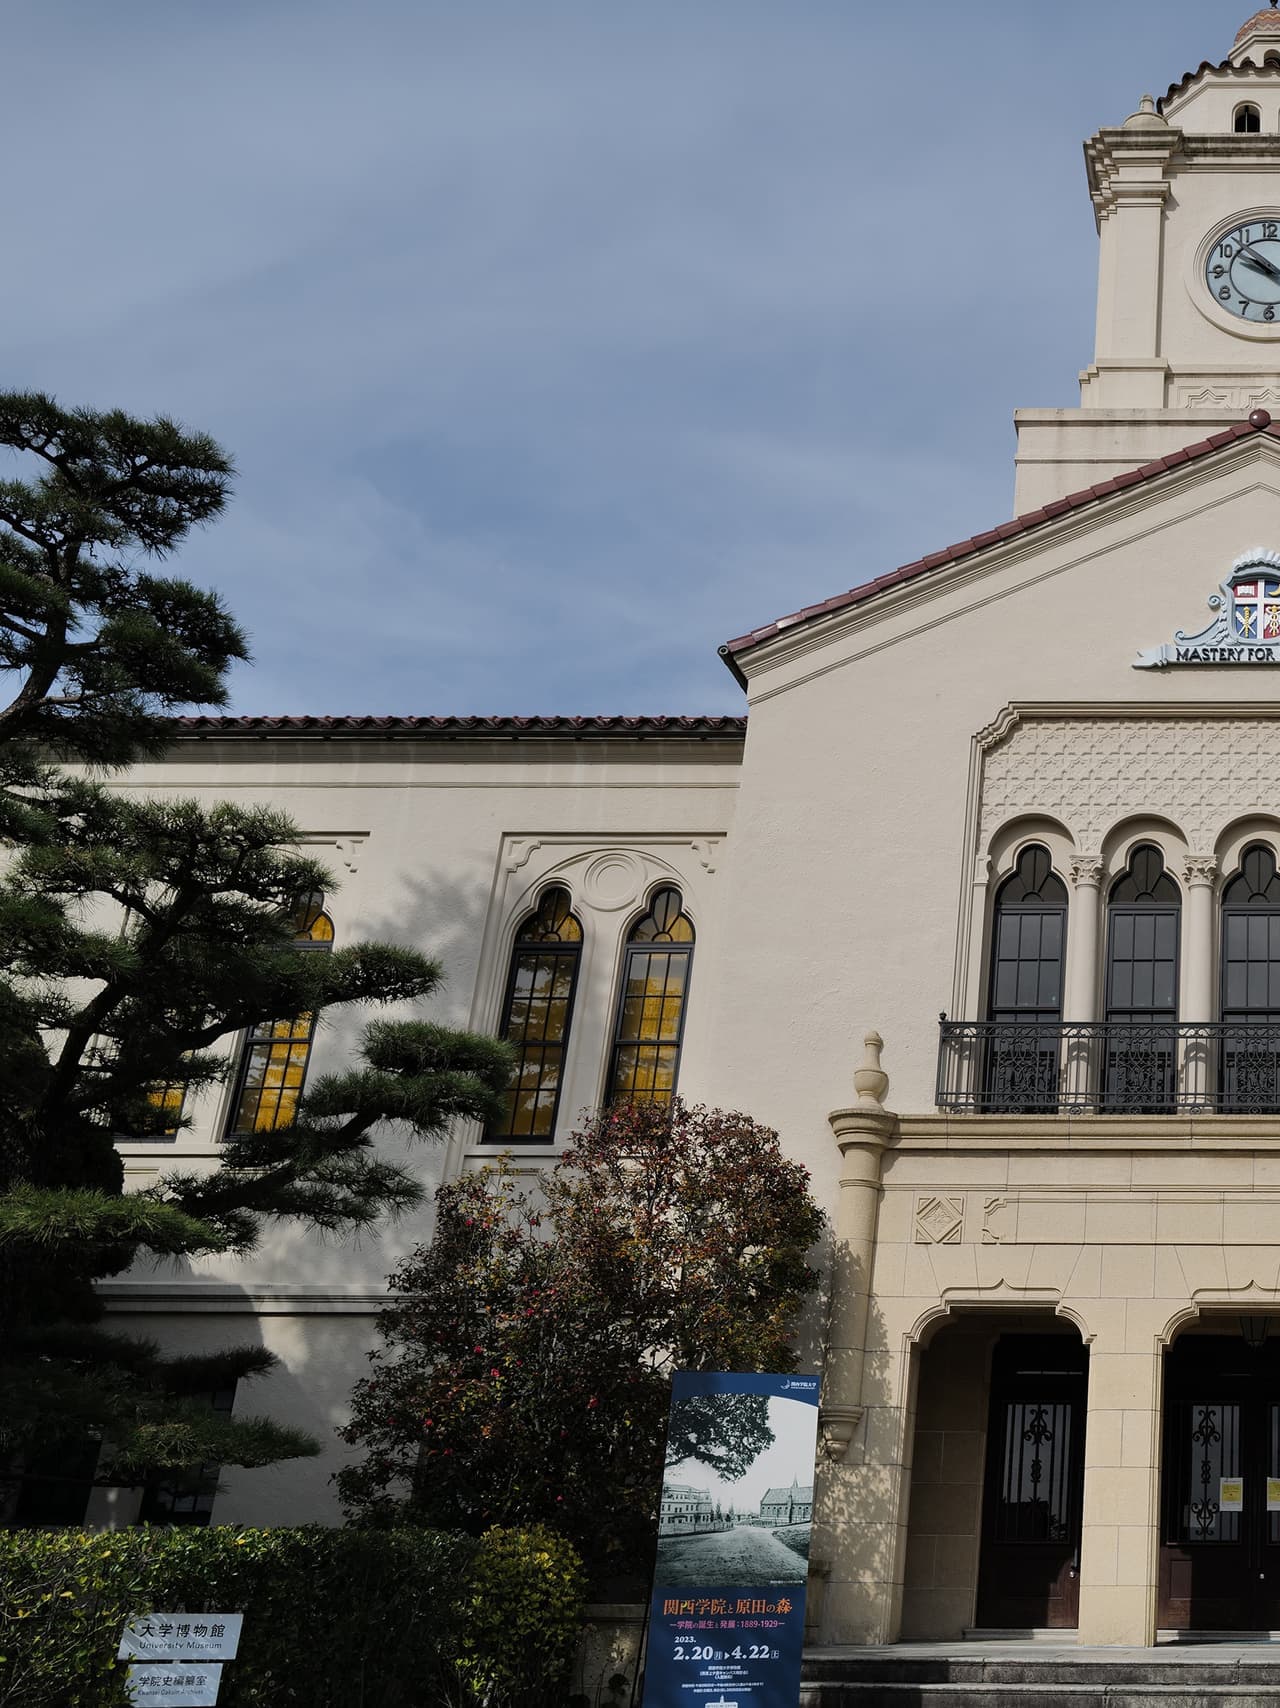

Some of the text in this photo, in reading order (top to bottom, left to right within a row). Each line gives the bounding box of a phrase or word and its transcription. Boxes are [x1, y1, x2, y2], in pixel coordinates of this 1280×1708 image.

[1239, 229, 1250, 243] 11
[1262, 223, 1278, 238] 12
[1220, 244, 1233, 258] 10
[1213, 264, 1225, 279] 9
[1219, 285, 1231, 300] 8
[1239, 301, 1250, 315] 7
[1263, 305, 1275, 320] 6
[1176, 648, 1244, 662] MASTERY
[1247, 647, 1275, 661] FOR
[663, 1598, 793, 1616] 関西学院と原田の森
[140, 1623, 227, 1638] 大学博物館
[139, 1641, 222, 1650] University Museum
